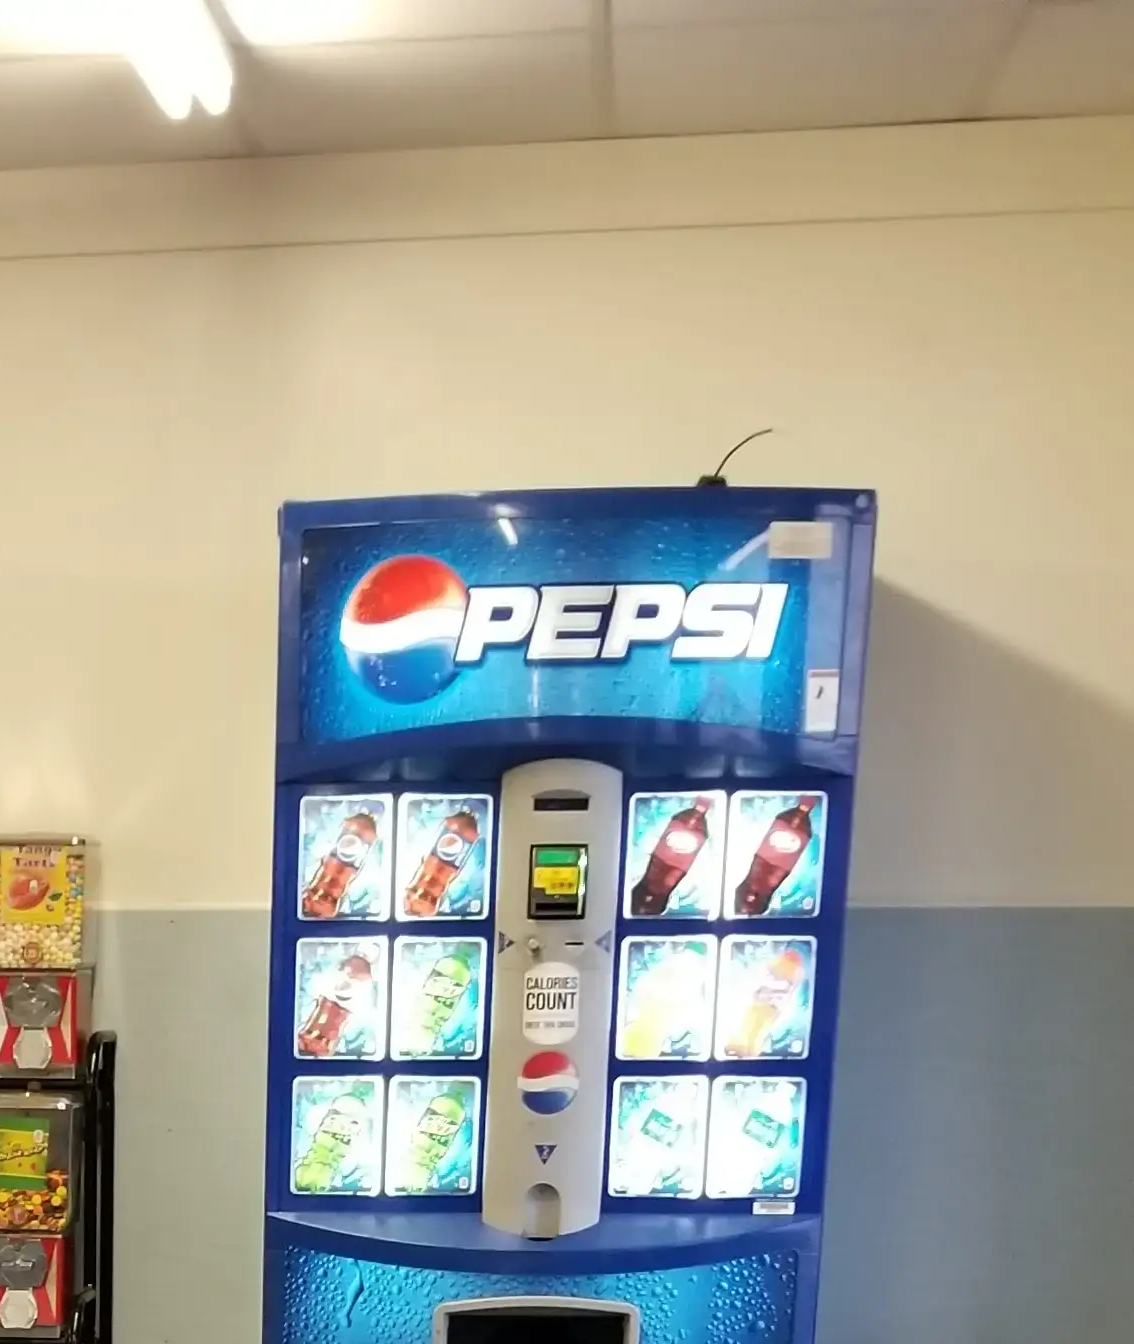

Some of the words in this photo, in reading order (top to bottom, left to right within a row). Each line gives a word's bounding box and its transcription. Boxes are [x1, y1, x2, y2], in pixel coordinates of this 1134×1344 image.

[454, 583, 789, 662] PEPSI
[526, 976, 578, 990] CALORIES
[525, 992, 577, 1011] COUNT
